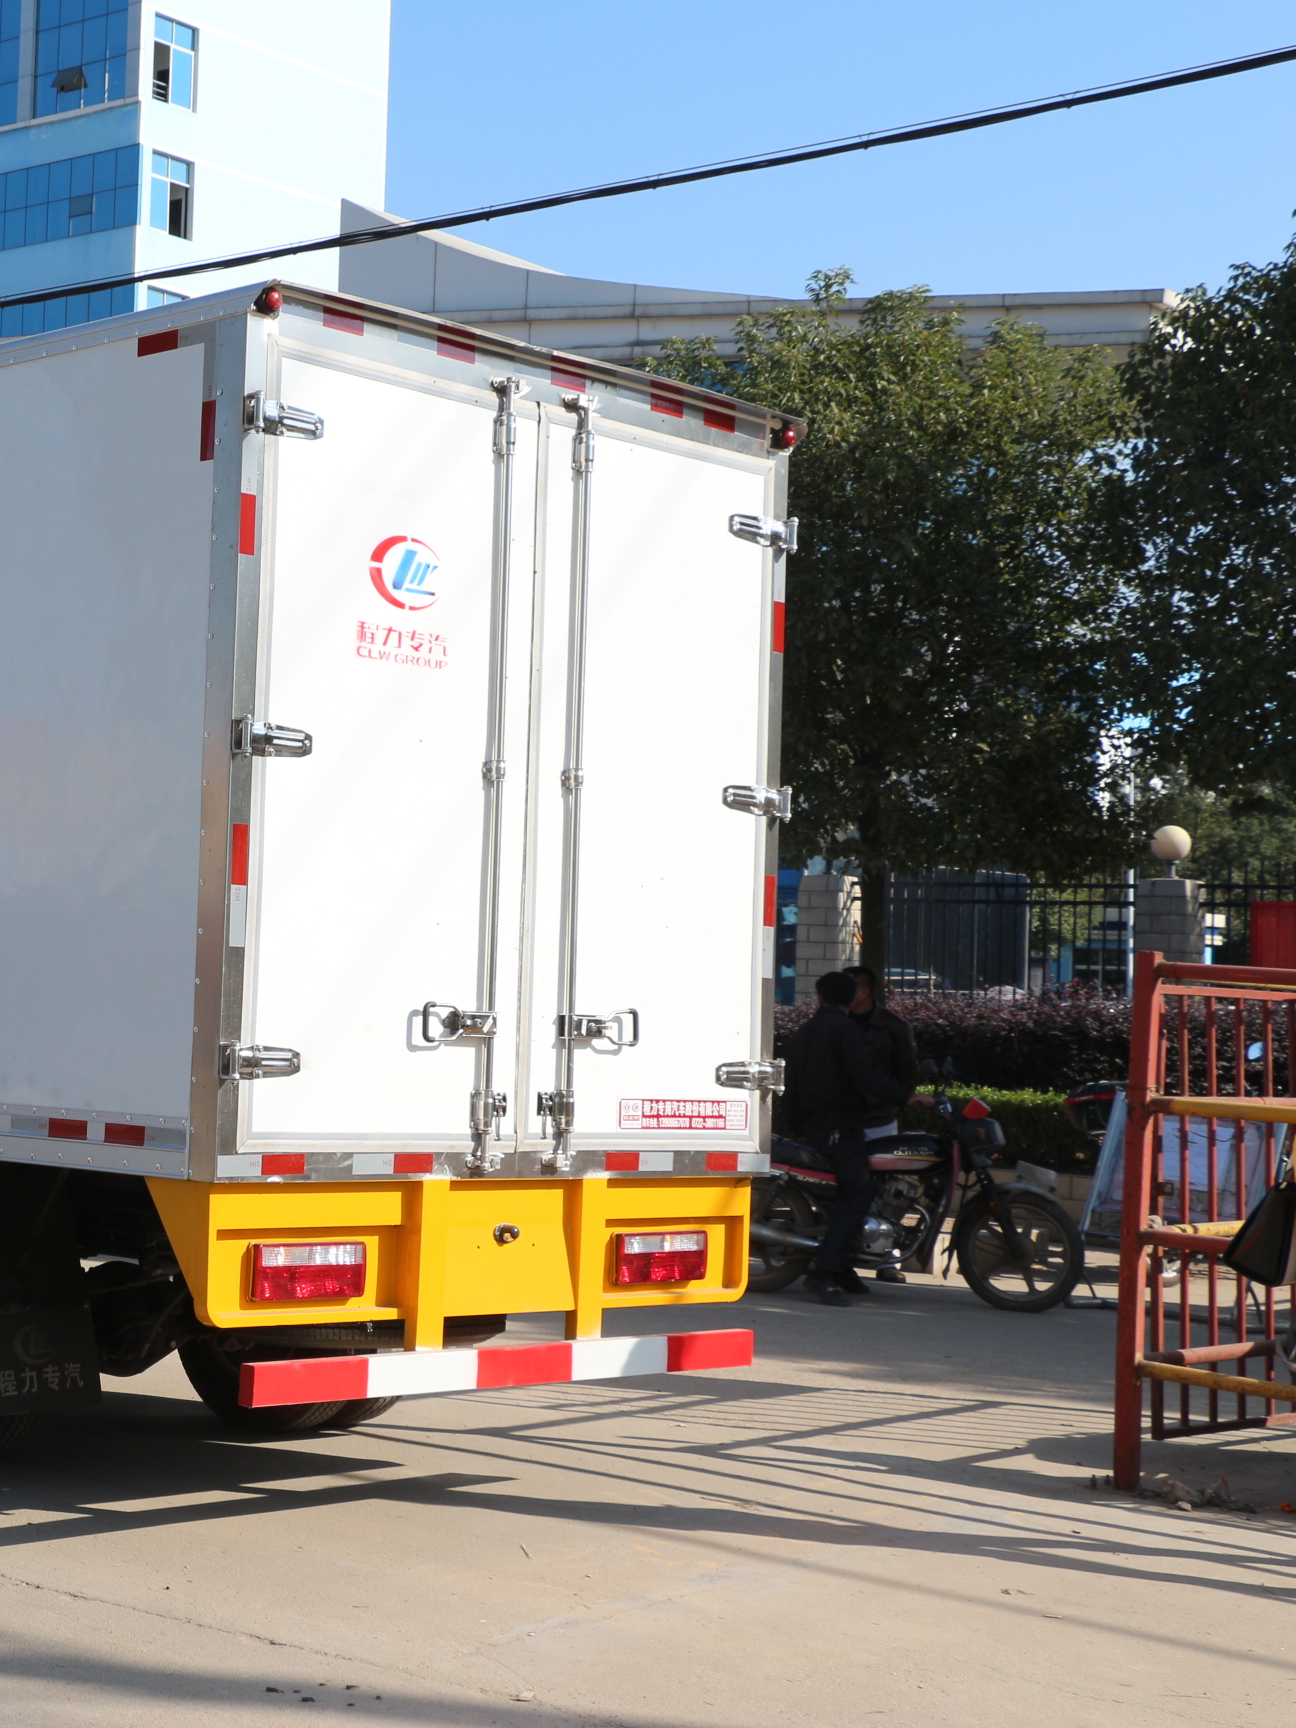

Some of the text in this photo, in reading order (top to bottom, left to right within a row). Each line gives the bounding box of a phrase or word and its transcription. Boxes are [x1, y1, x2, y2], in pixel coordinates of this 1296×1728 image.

[356, 620, 449, 657] 程力专汽
[356, 645, 449, 670] CLW GROUP
[642, 1100, 726, 1117] 程力专用汽车股份有限公司
